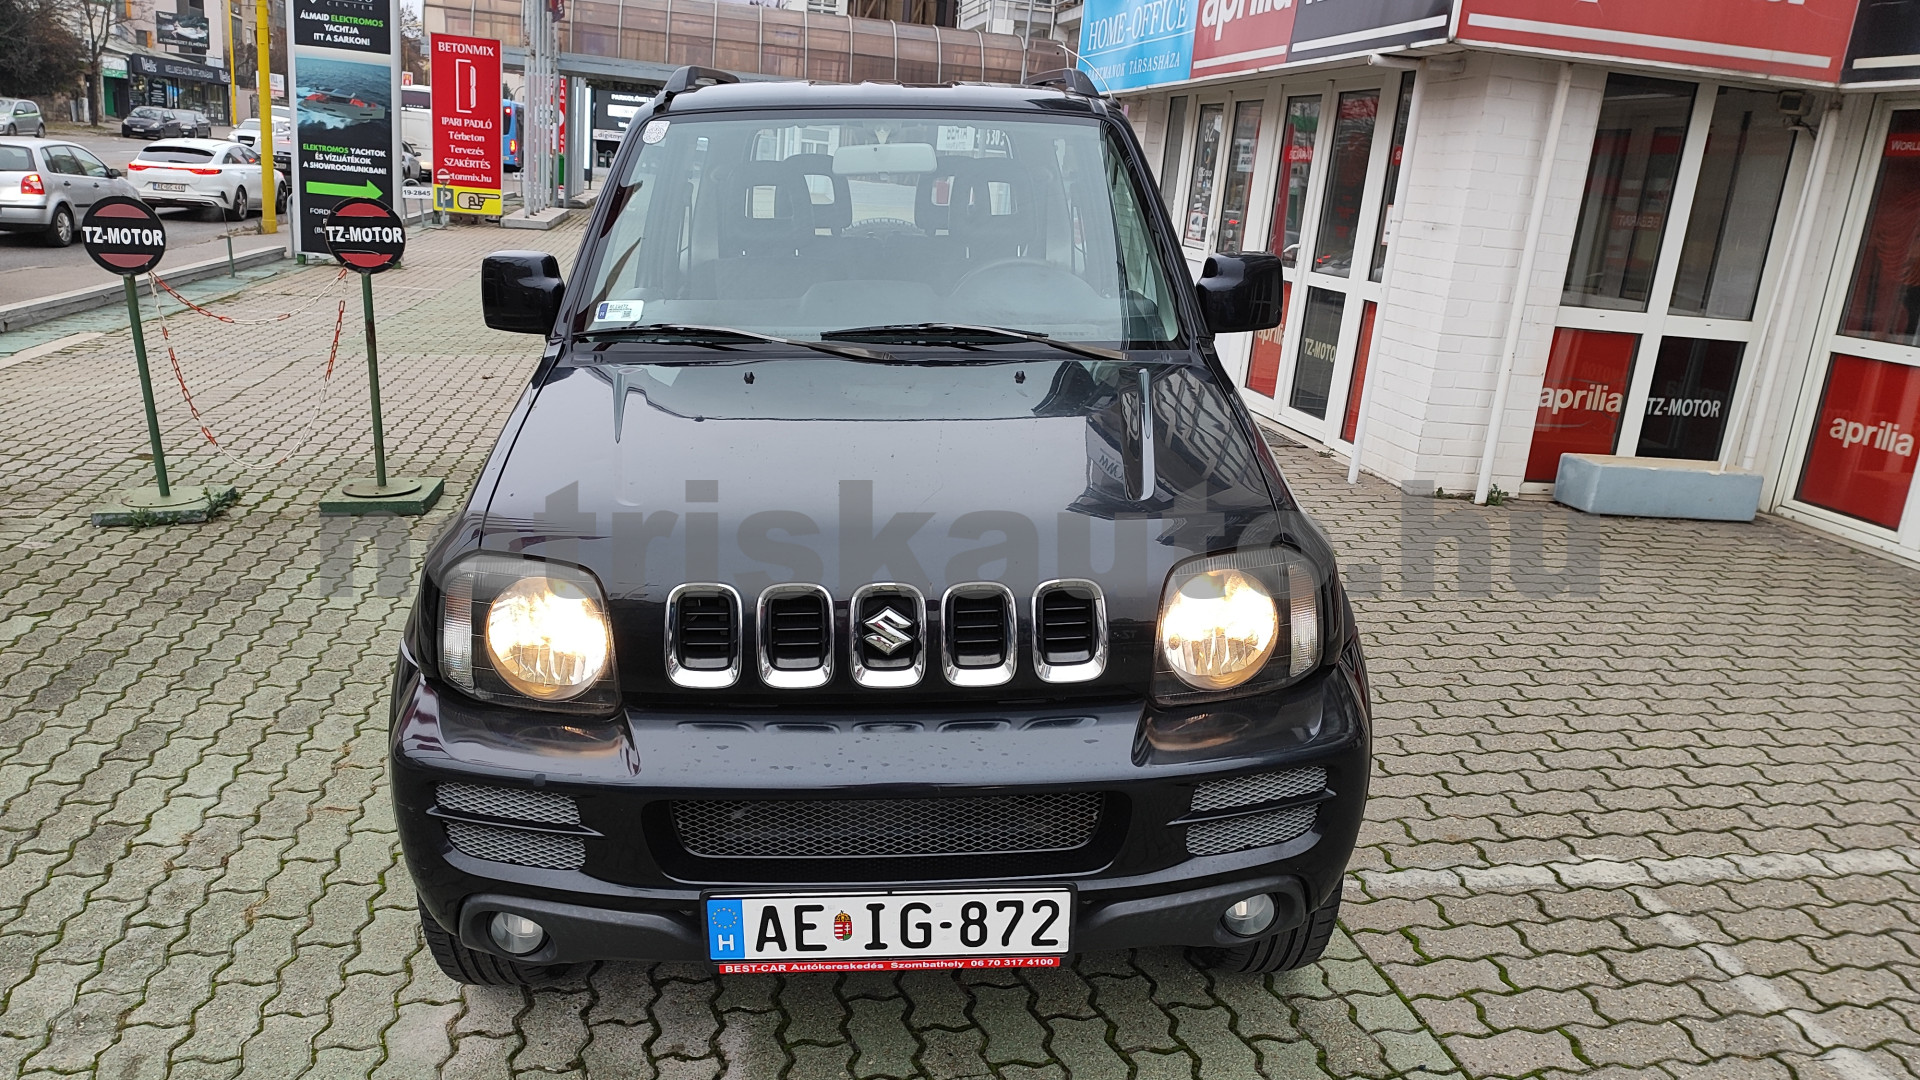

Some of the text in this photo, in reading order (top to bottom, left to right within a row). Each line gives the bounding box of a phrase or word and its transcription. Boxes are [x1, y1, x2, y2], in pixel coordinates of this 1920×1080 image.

[322, 1, 373, 11] CENTER
[300, 10, 384, 27] ÁLMAID ELEKTROMOS
[1087, 0, 1188, 50] HOME-OFFICE
[324, 24, 359, 34] YACHTJA
[334, 36, 370, 45] SARKON!
[438, 41, 494, 57] BETONMIX
[1129, 50, 1180, 75] TÁRSASHÁZA
[441, 116, 492, 129] IPARI PADLÓ
[448, 131, 485, 142] Térbeton
[303, 143, 387, 157] ELEKTROMOS YACHTOK
[314, 152, 323, 160] ÉS
[449, 144, 484, 155] Tervezés
[310, 161, 387, 175] SHOWROOMUNKBAN!
[444, 157, 490, 169] SZAKÉRTÉS
[449, 172, 492, 183] etonmix.hu
[82, 226, 164, 246] TZ-MOTOR
[326, 226, 404, 243] TZ-MOTOR
[1304, 337, 1338, 363] TZ-MOTO
[1540, 383, 1624, 414] aprilia
[1647, 397, 1721, 418] TZ-MOTOR
[1829, 417, 1915, 457] aprilia
[755, 899, 1060, 952] AE IG-872
[718, 934, 735, 951] H
[725, 958, 1054, 974] BEST-CAR Autókereskedés Szombathely 06 70 317 4100
